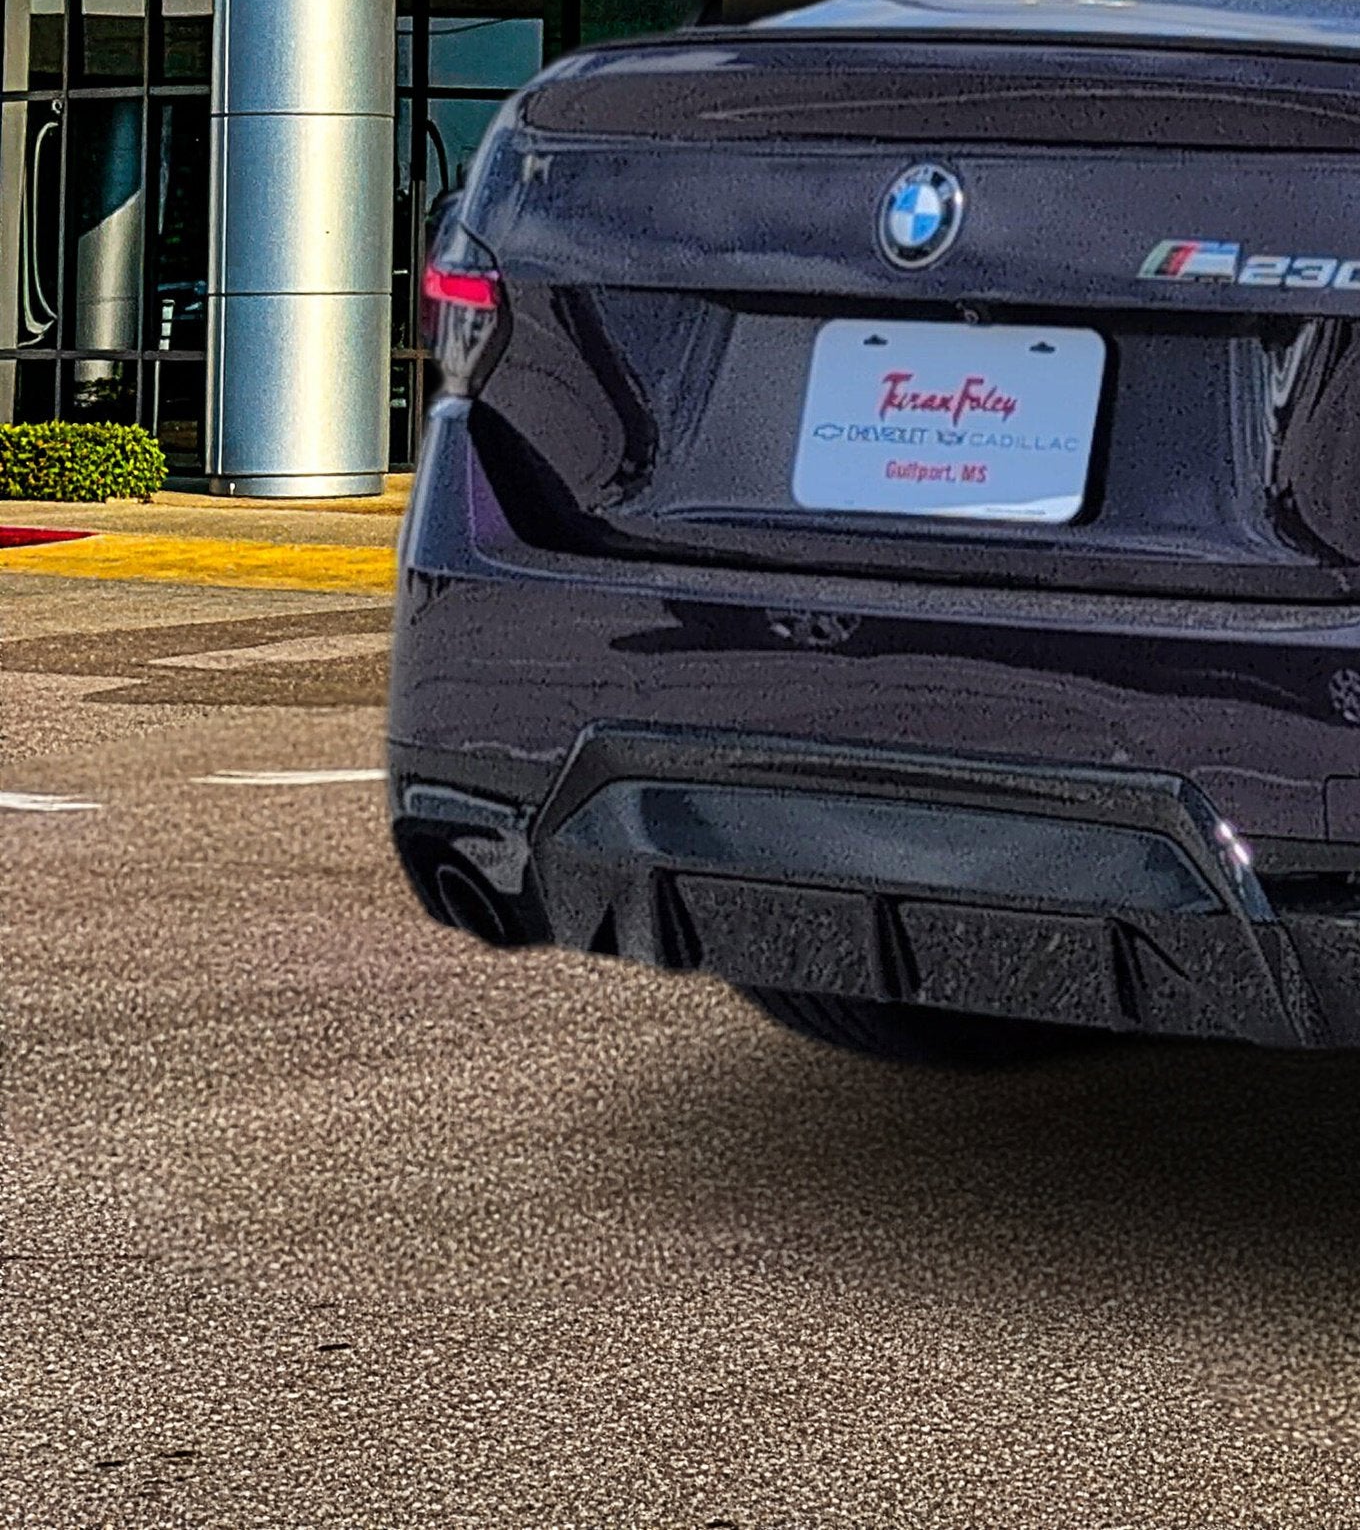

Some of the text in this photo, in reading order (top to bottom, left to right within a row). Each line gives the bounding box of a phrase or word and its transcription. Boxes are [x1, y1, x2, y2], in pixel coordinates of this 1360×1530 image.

[952, 378, 1017, 427] Foley
[970, 433, 1078, 452] CADILLAC
[962, 465, 987, 483] MS
